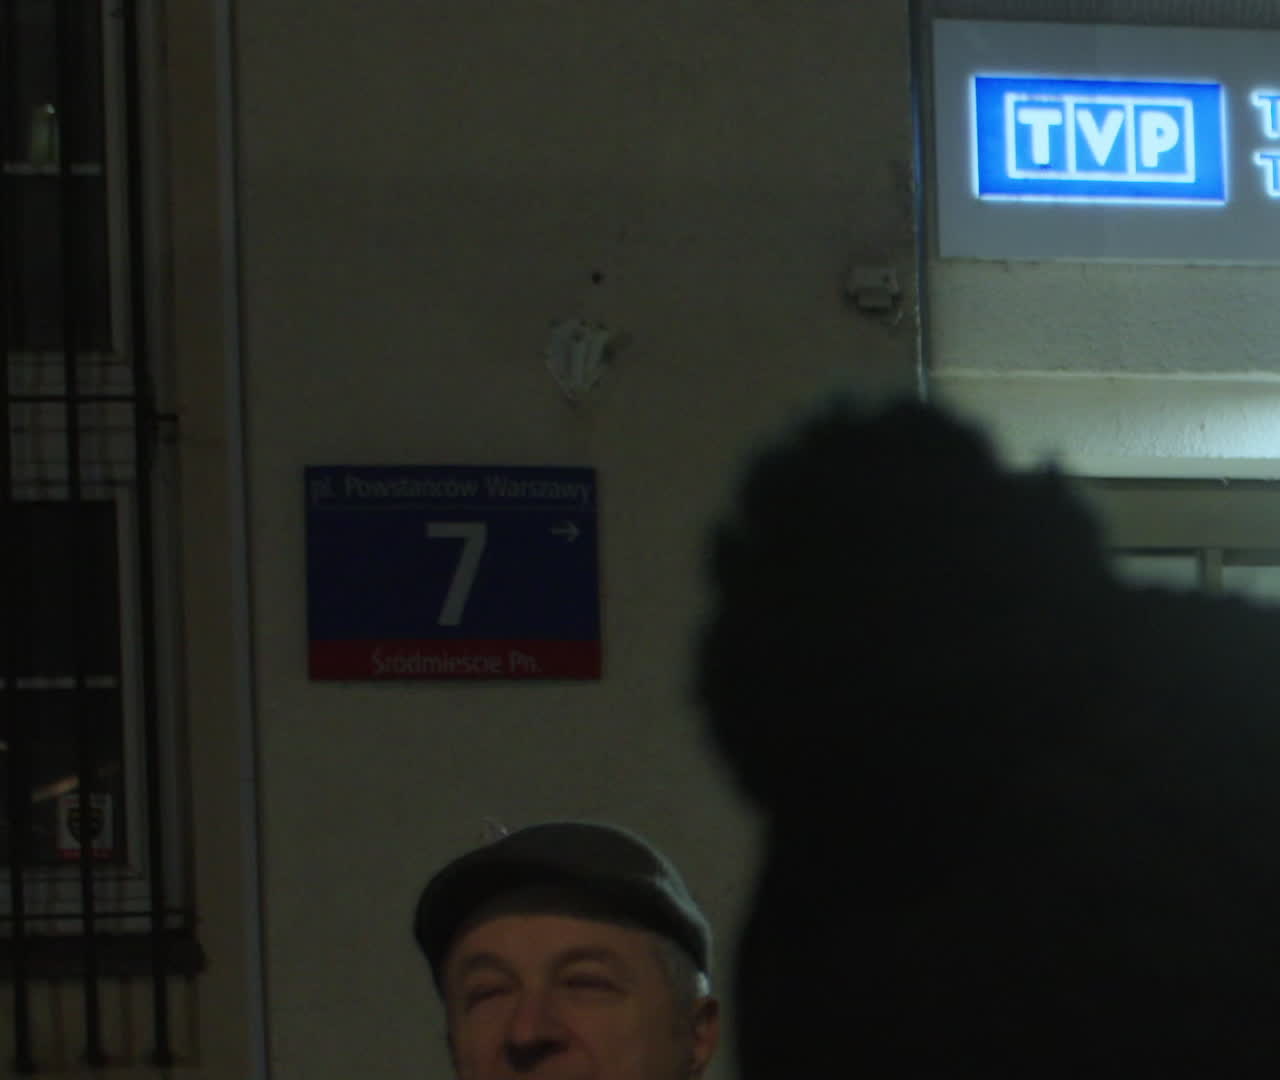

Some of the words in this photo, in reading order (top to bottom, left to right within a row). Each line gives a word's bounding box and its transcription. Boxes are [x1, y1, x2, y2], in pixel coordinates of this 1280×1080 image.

[1016, 107, 1181, 171] TVP
[483, 472, 593, 511] Warszawy
[425, 521, 488, 628] 7
[508, 648, 543, 674] Pn.
